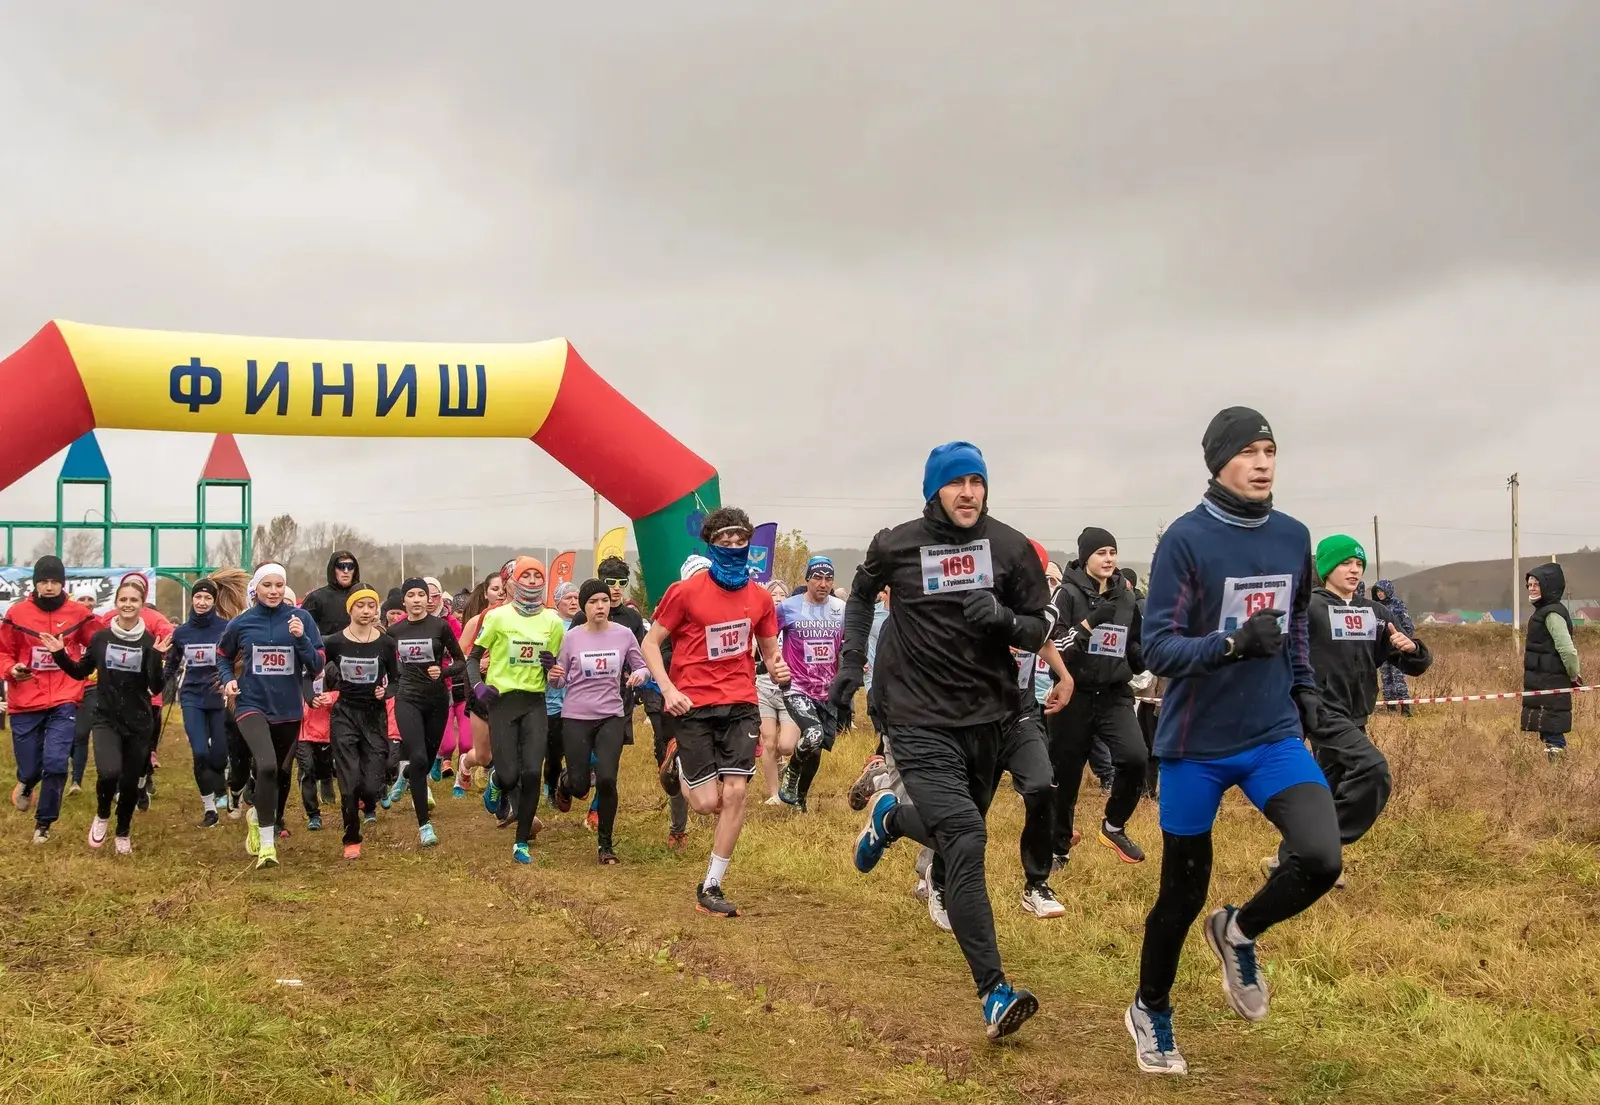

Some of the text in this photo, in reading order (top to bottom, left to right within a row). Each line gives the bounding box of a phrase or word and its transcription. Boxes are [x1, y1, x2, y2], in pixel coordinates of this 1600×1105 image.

[169, 357, 487, 417] ФИНИШ
[928, 544, 983, 556] Королева спорта
[940, 554, 975, 577] 169
[942, 578, 975, 587] г.Туймазы
[1234, 579, 1286, 591] Королева спорта
[1244, 592, 1276, 618] 137
[795, 620, 841, 629] RUNNING
[1344, 615, 1363, 630] 99
[720, 631, 739, 647] 113
[797, 629, 839, 638] TUIMAZY
[1102, 632, 1117, 646] 28
[408, 646, 422, 656] 22
[520, 646, 534, 659] 23
[812, 646, 829, 656] 152
[121, 652, 127, 664] 1
[262, 653, 286, 666] 296
[595, 658, 607, 670] 21
